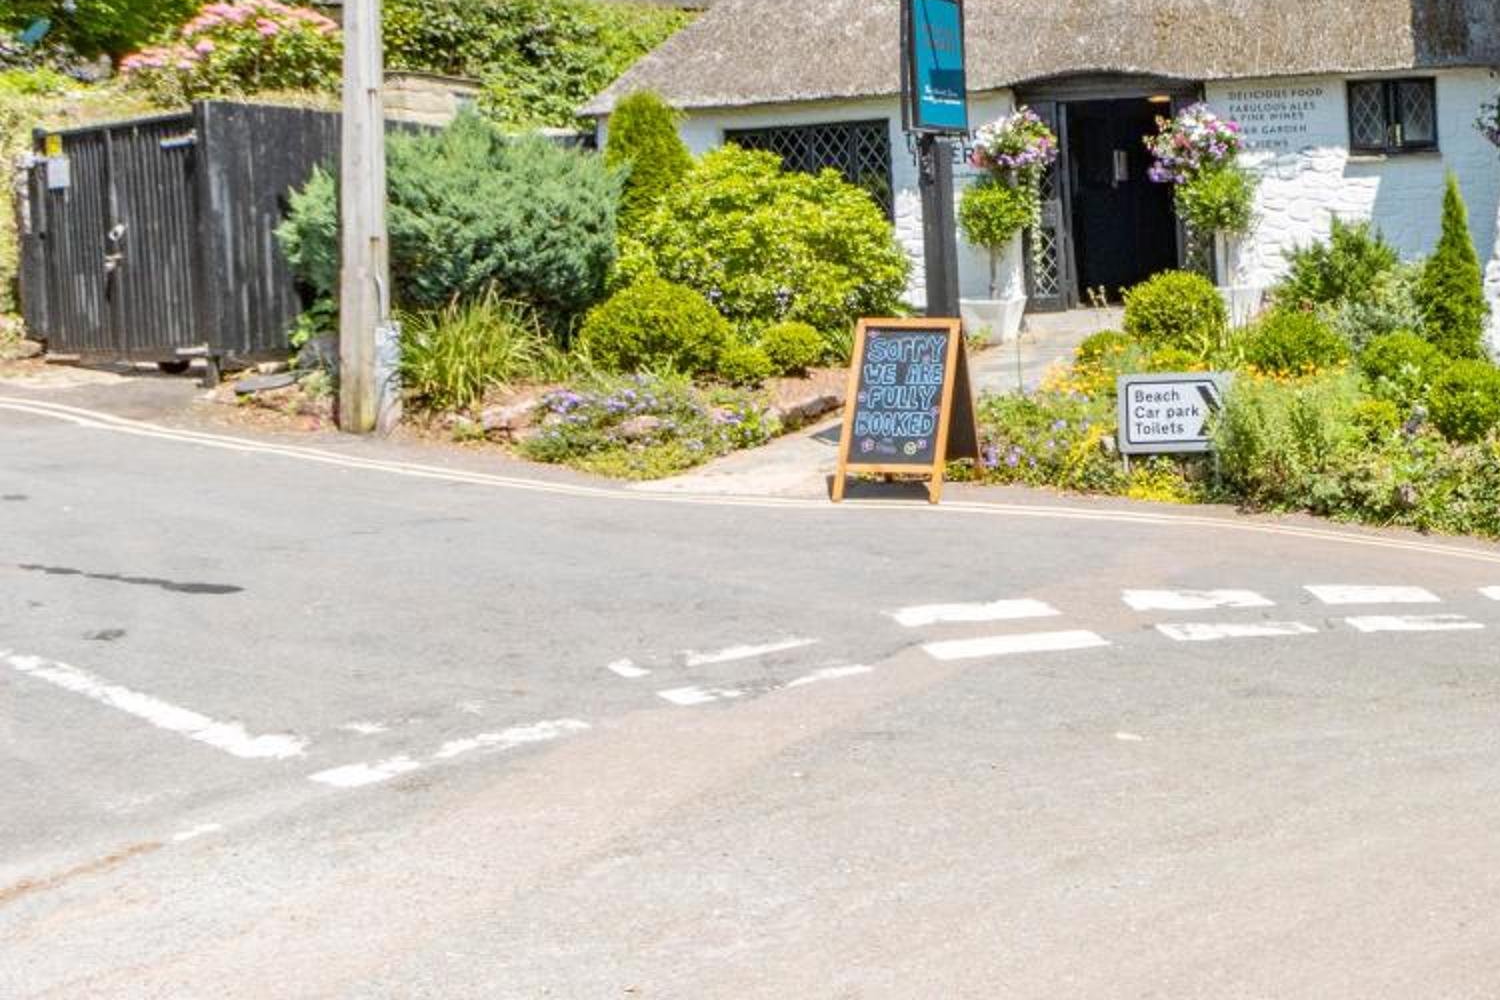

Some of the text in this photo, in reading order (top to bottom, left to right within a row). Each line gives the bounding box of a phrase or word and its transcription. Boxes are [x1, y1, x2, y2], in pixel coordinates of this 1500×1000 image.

[1228, 87, 1323, 101] DELICIOUS FOOD
[1229, 101, 1316, 113] FABULOUS ALES
[1261, 124, 1307, 134] GARDEN
[864, 363, 944, 385] WE ARE
[867, 386, 937, 410] FULLY
[1135, 387, 1181, 403] Beach
[1135, 404, 1200, 419] Car park
[855, 411, 935, 437] BOOKED
[1136, 422, 1185, 435] Toilets
